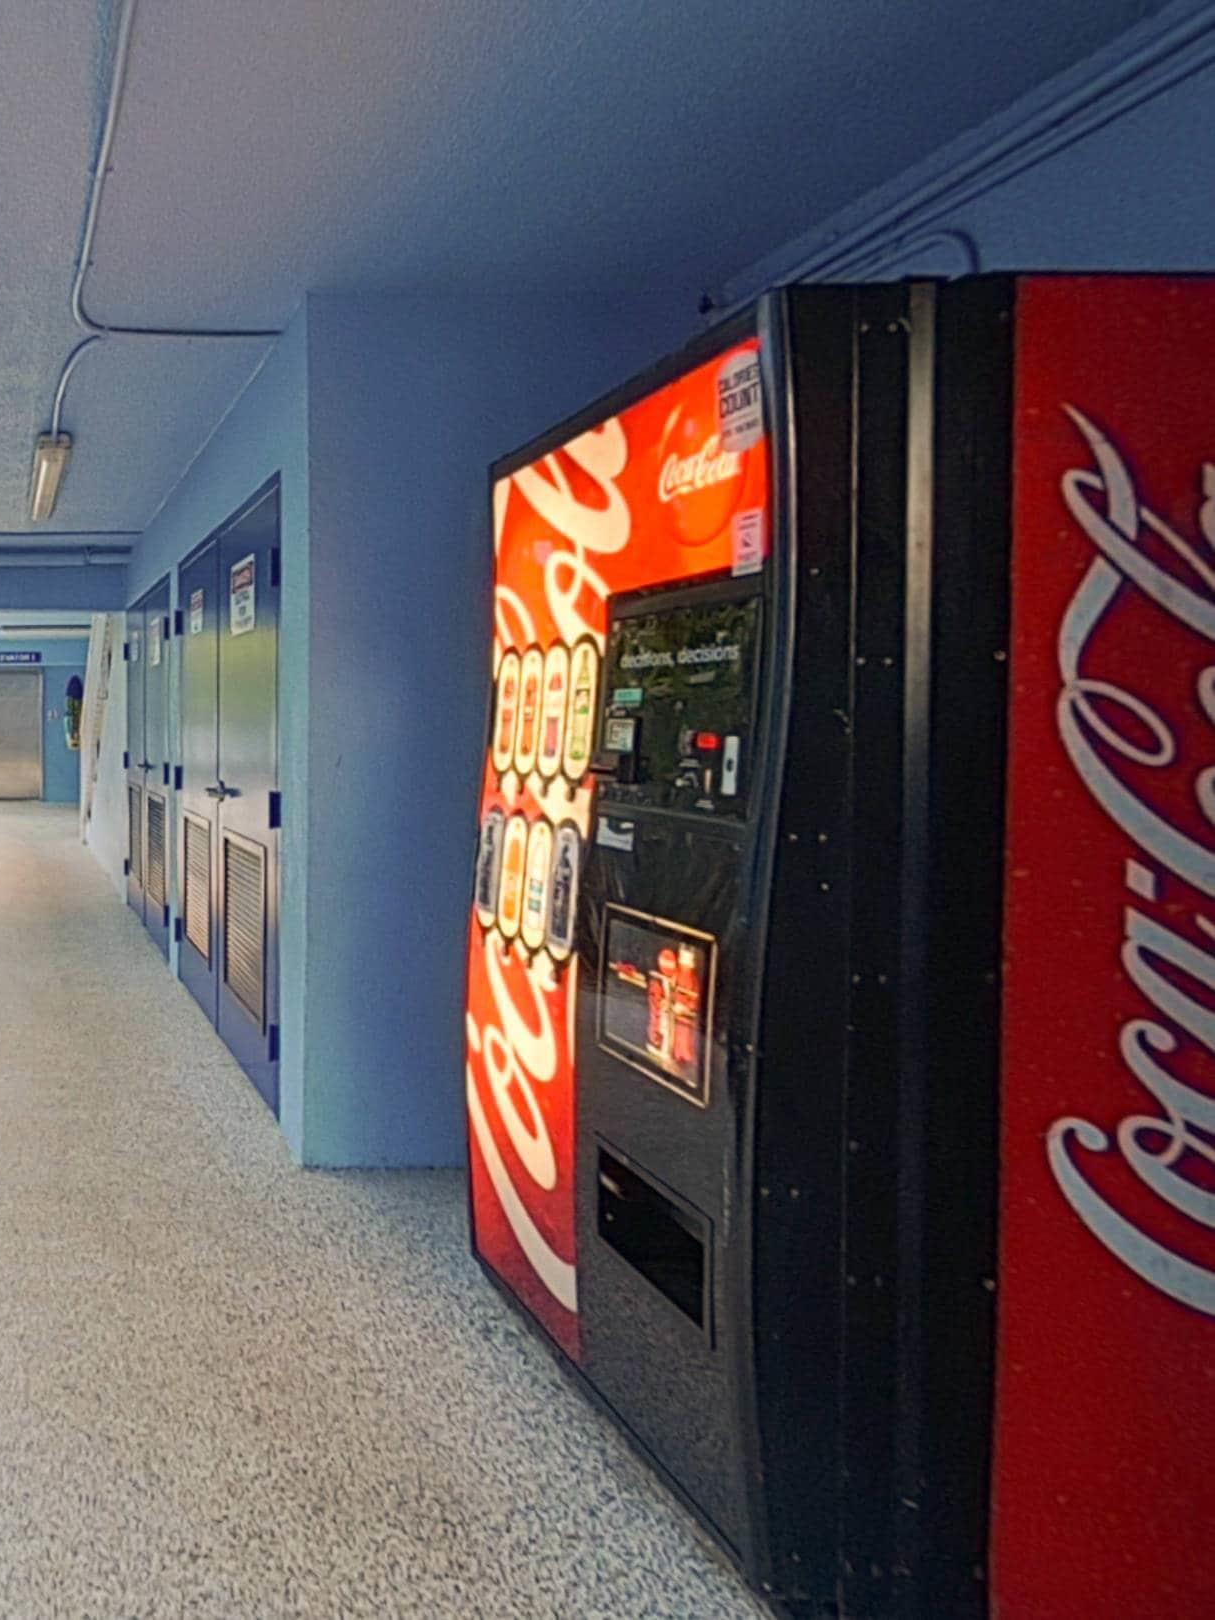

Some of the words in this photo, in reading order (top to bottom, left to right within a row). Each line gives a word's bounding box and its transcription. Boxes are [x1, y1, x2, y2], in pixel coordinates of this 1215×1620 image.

[719, 381, 759, 419] COUNT
[676, 643, 740, 664] decisions
[1047, 402, 1215, 1317] Coca-Cl
